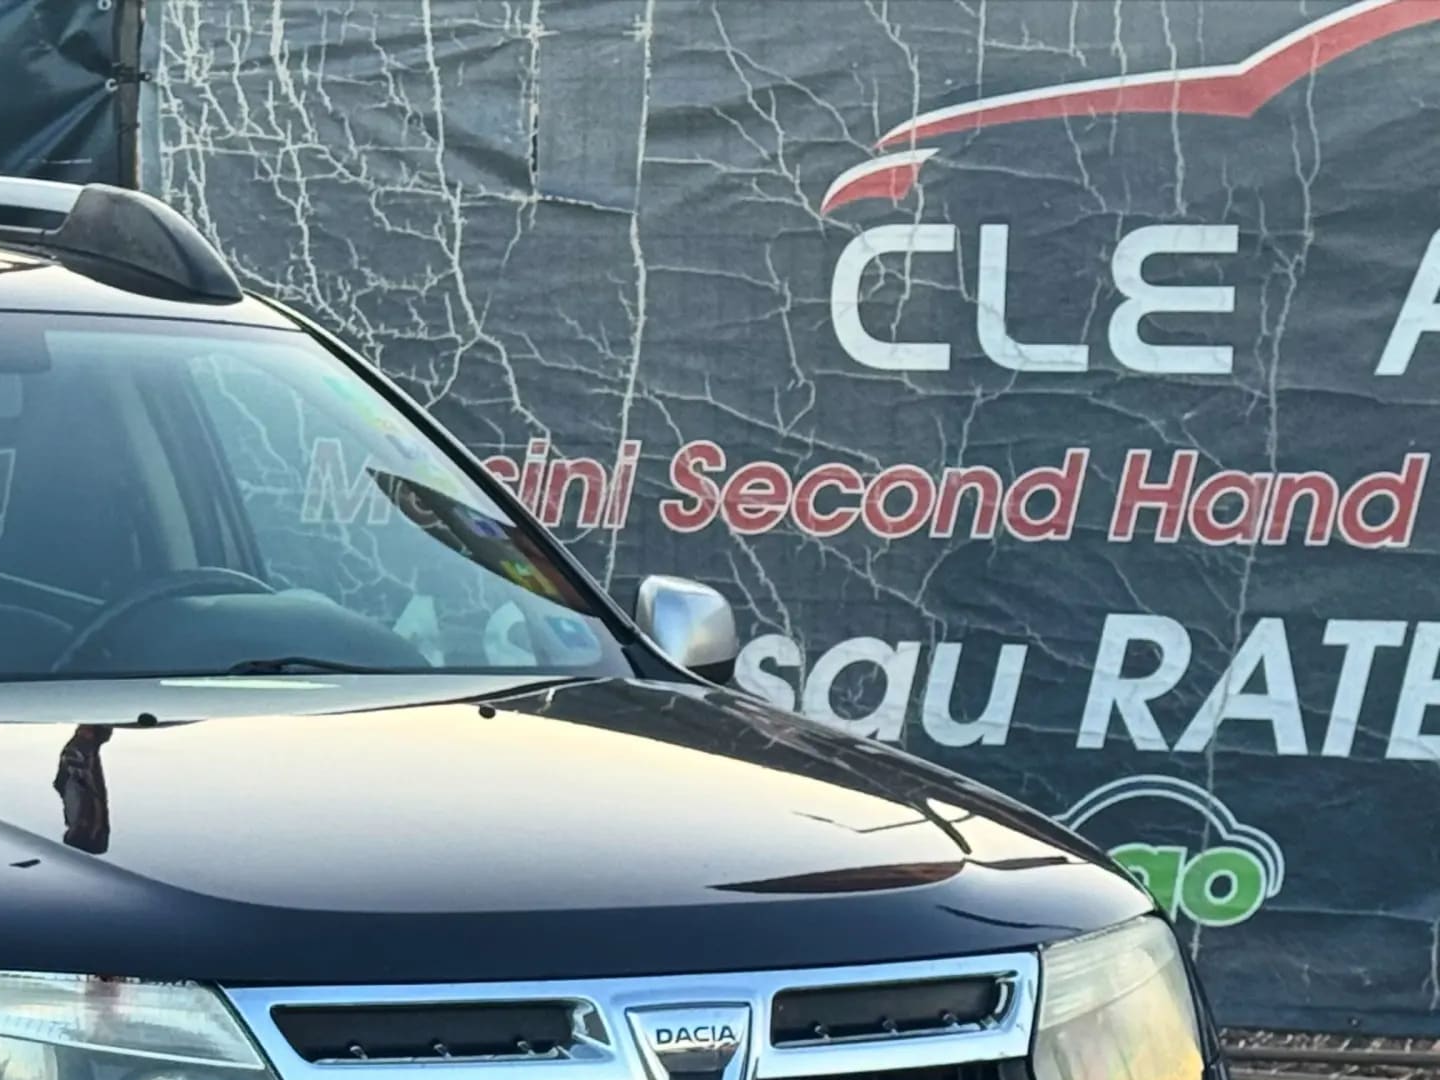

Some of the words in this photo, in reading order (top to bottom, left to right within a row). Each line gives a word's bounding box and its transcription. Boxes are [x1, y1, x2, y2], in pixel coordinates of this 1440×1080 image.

[831, 224, 1239, 374] CLE
[660, 440, 1089, 540] Second
[1108, 448, 1430, 546] Hand
[734, 633, 1028, 747] sau
[655, 1025, 736, 1045] DACIA
